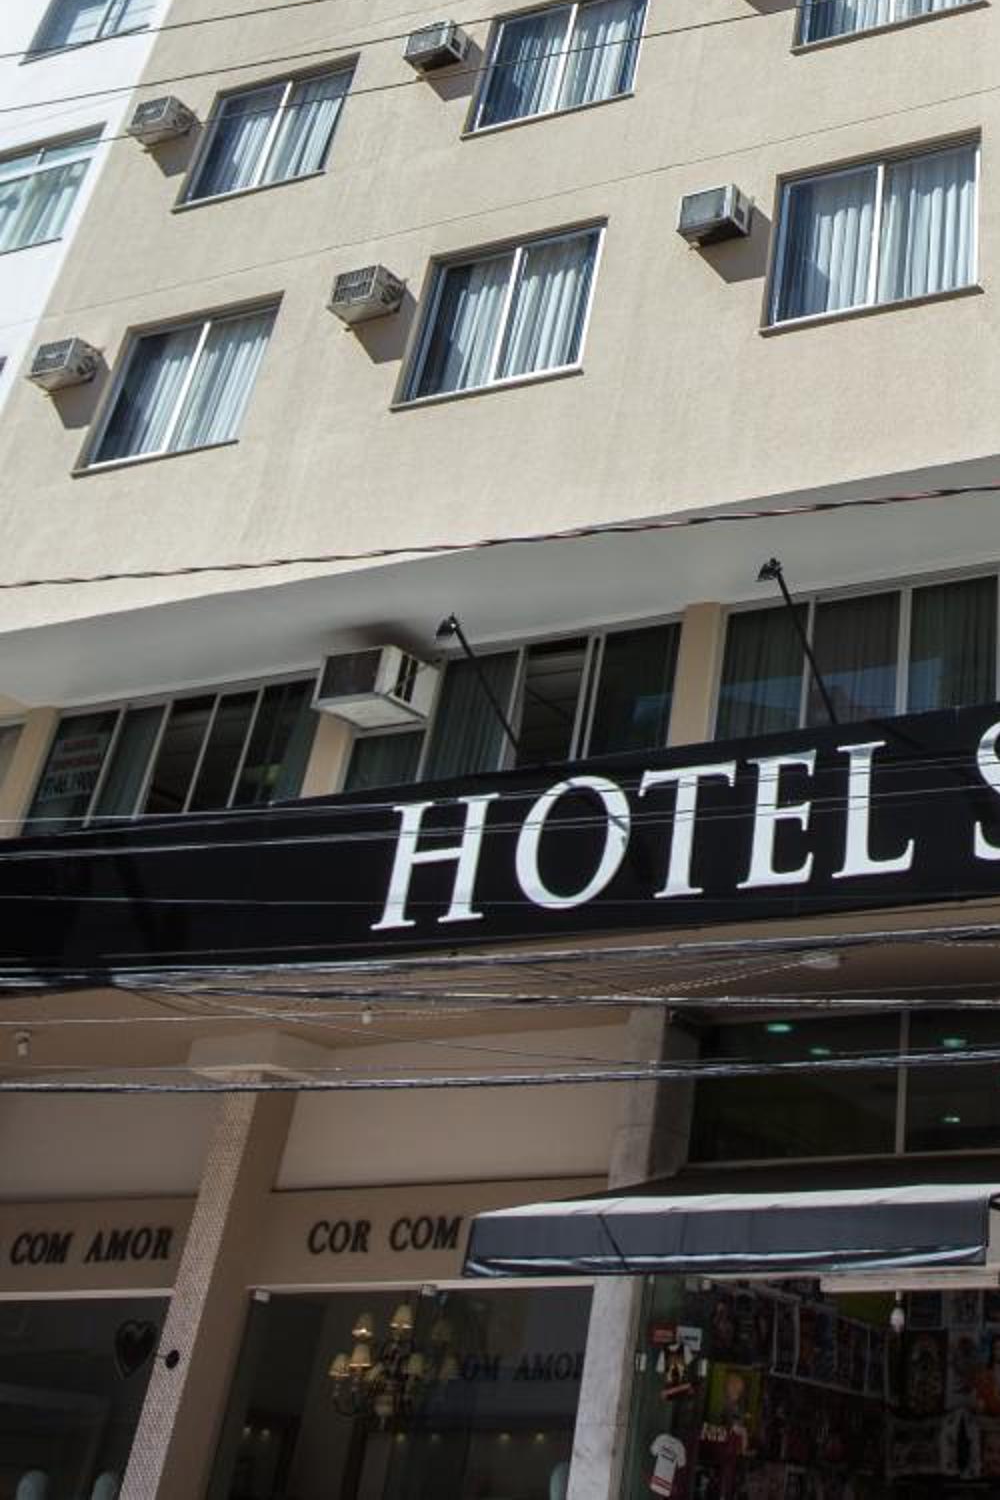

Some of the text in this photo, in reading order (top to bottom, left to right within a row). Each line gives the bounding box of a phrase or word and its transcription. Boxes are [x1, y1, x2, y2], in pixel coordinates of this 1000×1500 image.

[370, 740, 915, 931] HOTEL
[10, 1226, 174, 1265] COM AMOR
[307, 1215, 463, 1255] COR COM
